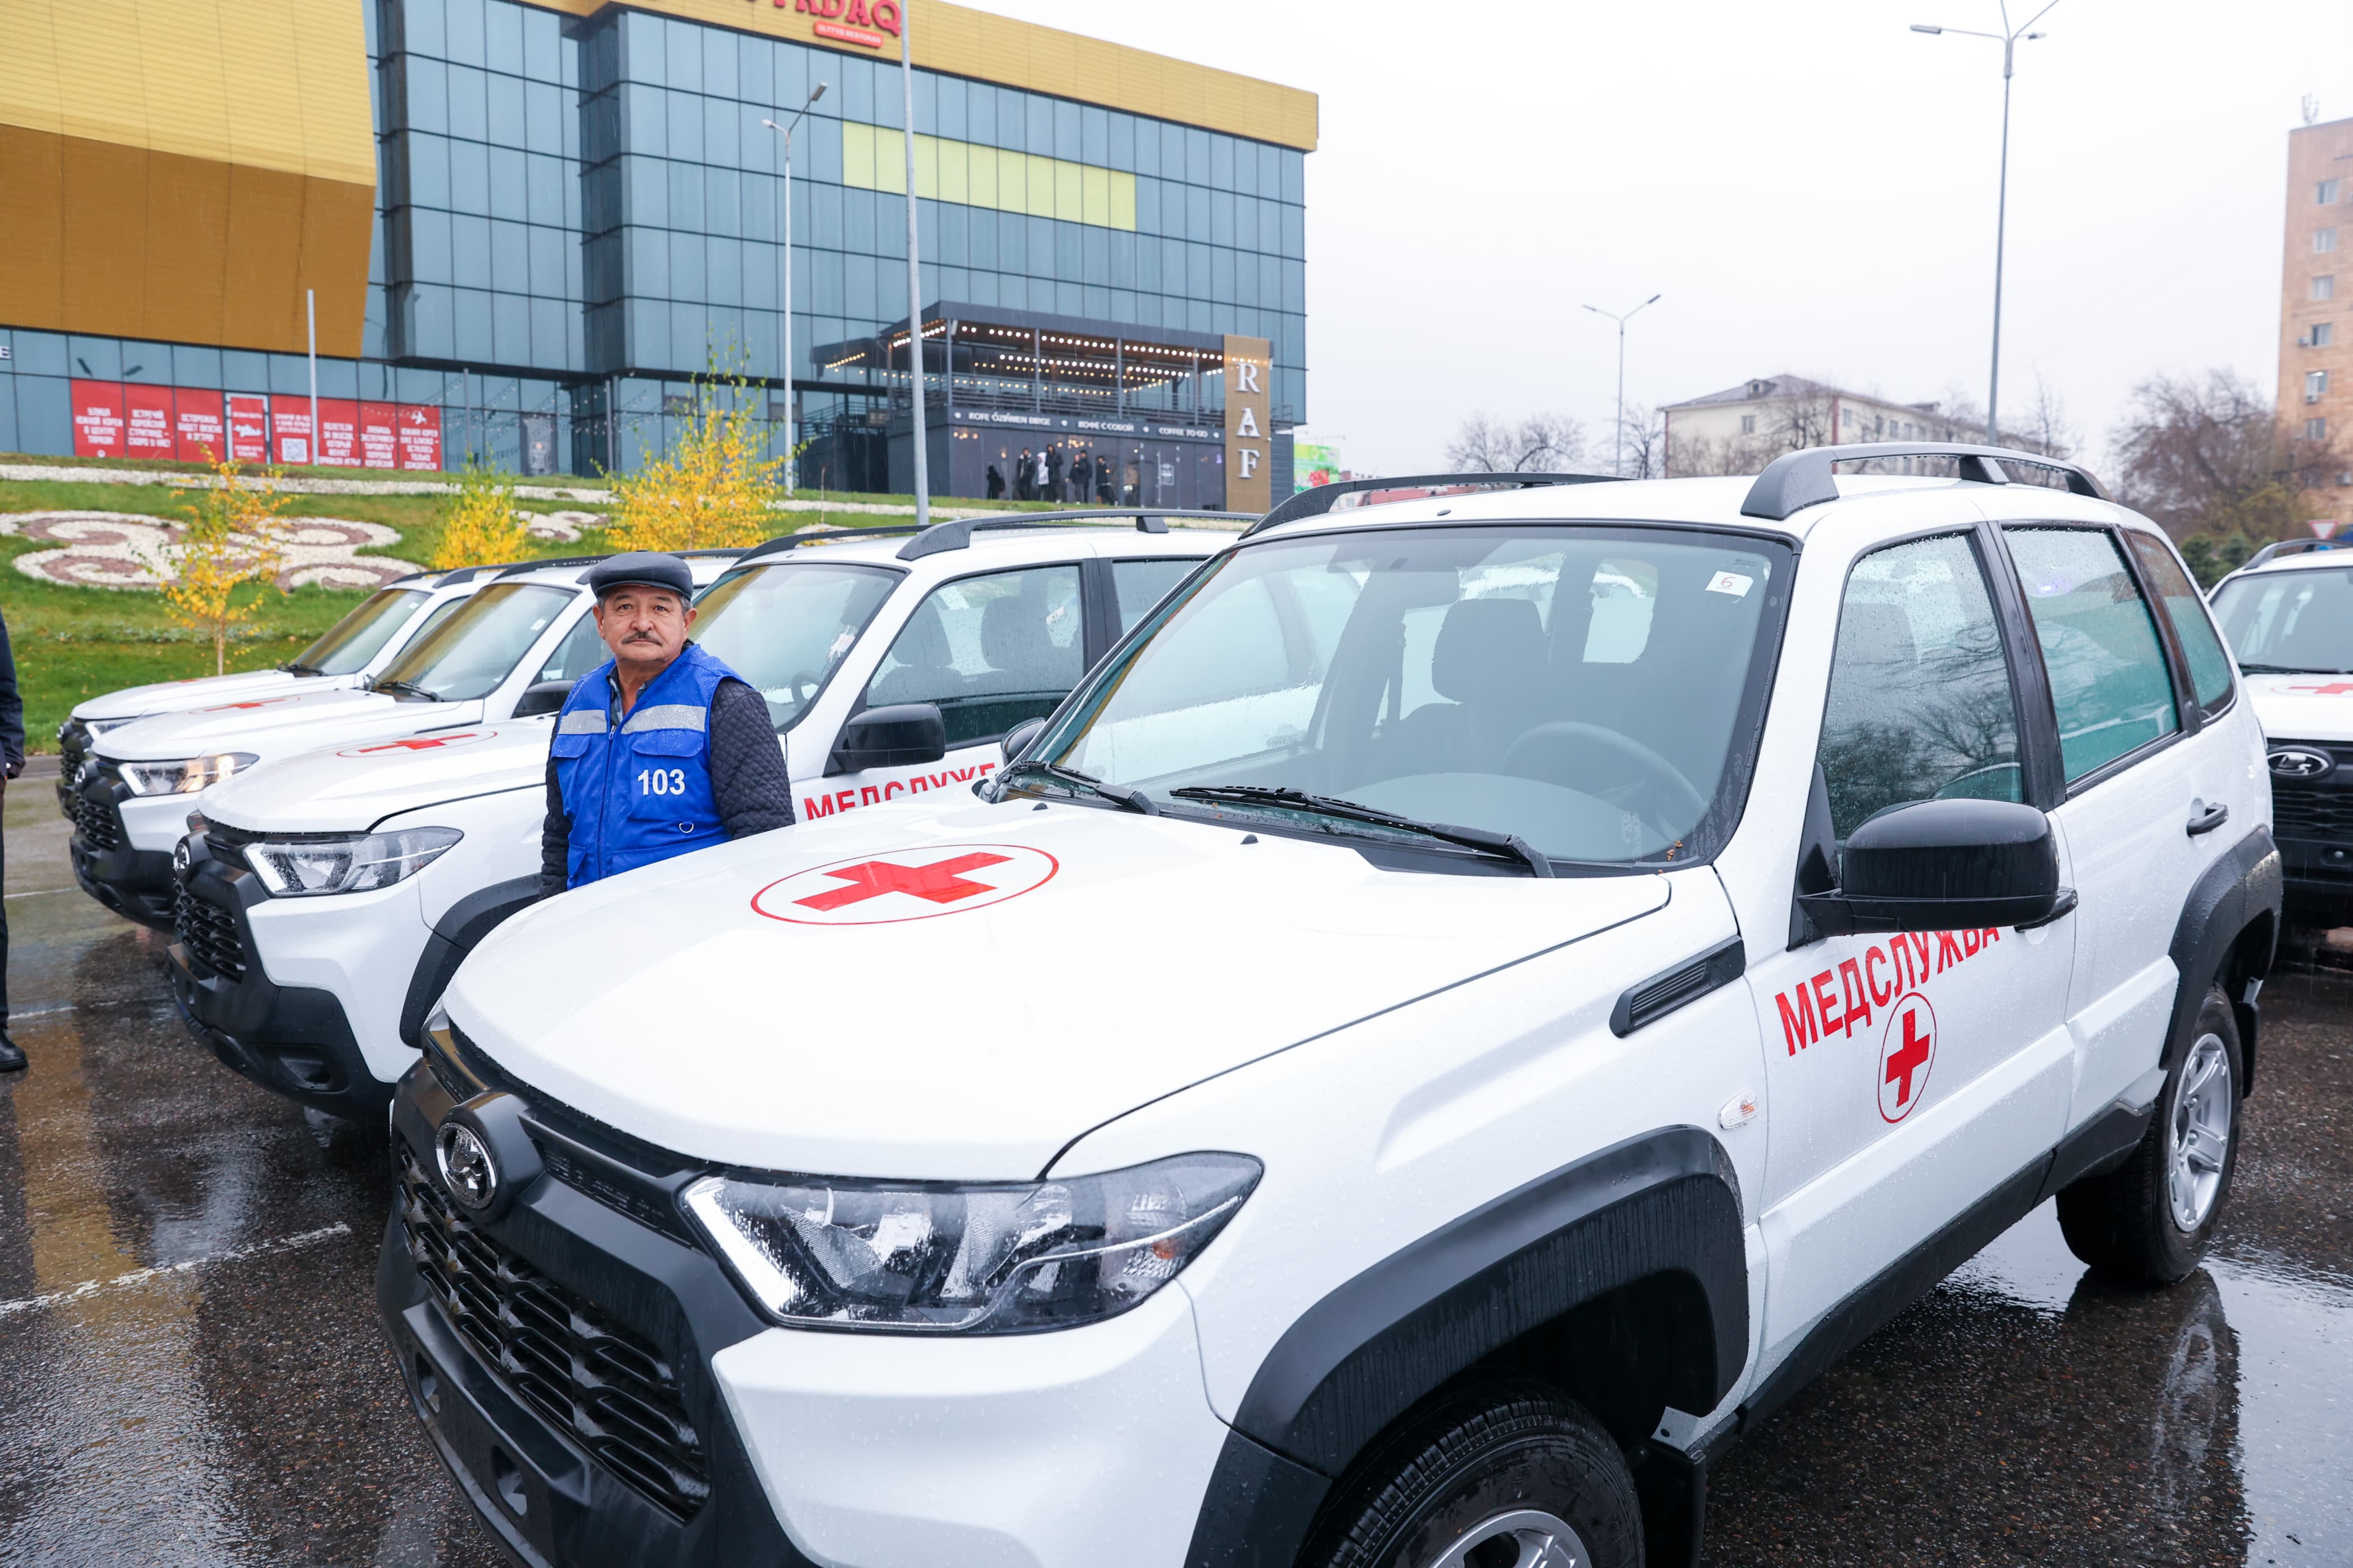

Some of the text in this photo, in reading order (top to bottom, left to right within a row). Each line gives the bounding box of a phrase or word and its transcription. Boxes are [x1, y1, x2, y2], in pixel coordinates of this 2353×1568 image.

[968, 412, 990, 422] KOFE
[1235, 362, 1261, 479] RAF
[1078, 420, 1100, 430] КОФЕ
[1158, 427, 1184, 437] COFFEE
[637, 768, 686, 796] 103
